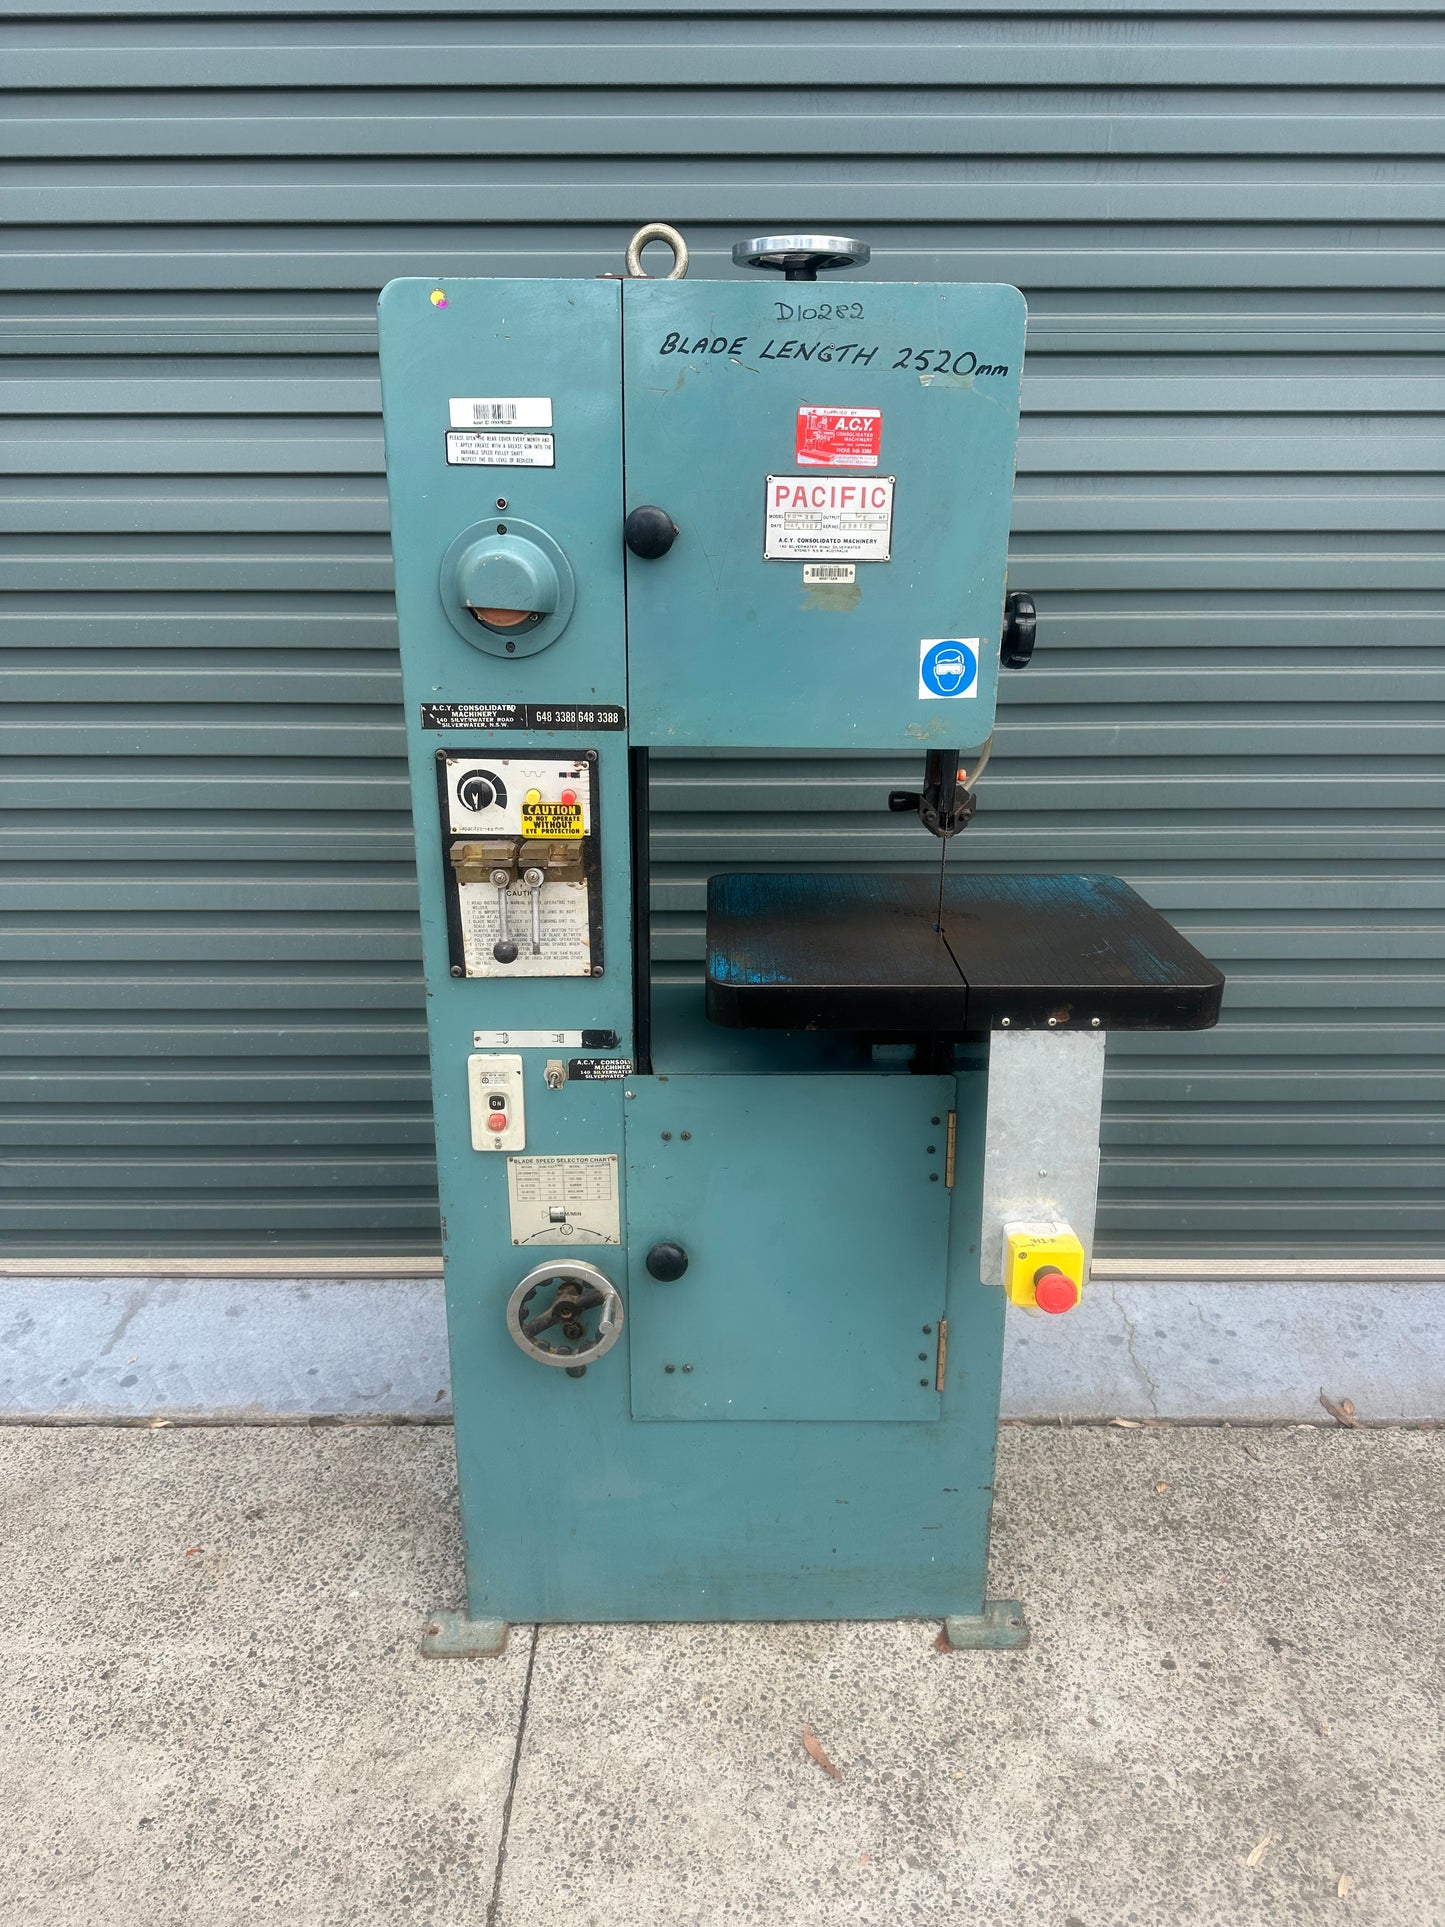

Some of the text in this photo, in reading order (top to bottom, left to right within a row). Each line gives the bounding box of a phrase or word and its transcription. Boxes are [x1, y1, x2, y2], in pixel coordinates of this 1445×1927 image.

[659, 332, 748, 355] BLADE
[759, 339, 879, 367] LENGTH
[835, 418, 874, 431] A.C.Y.
[776, 486, 886, 508] PACIFIC
[536, 711, 618, 723] 648 3388 648 3388
[528, 806, 576, 814] CAUTION
